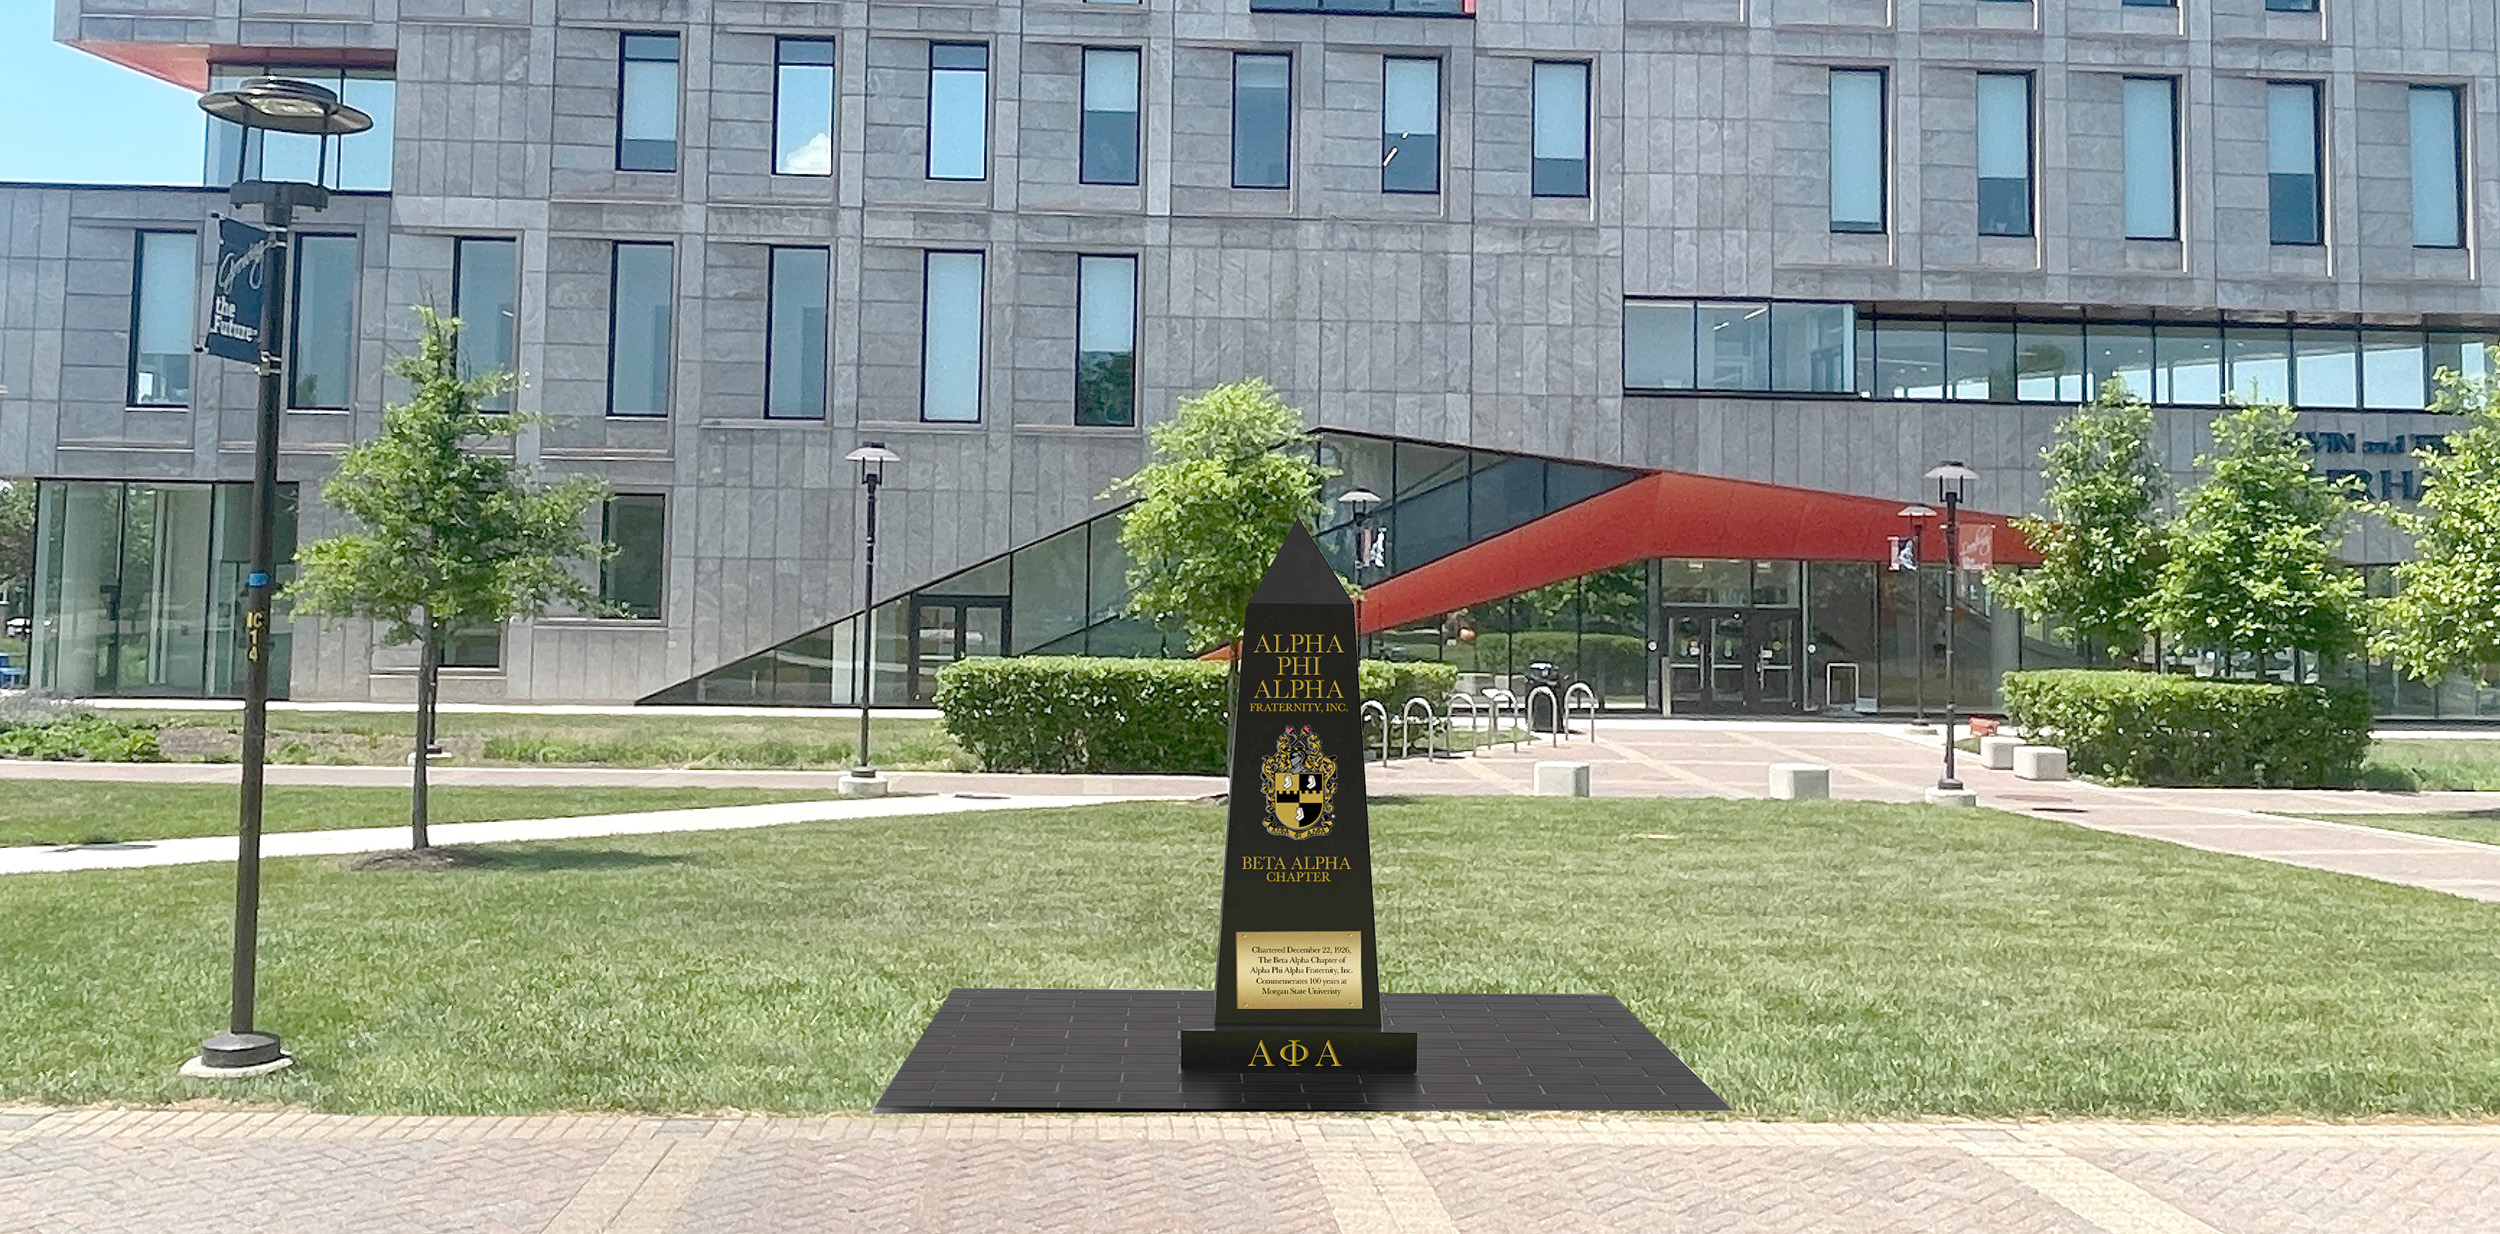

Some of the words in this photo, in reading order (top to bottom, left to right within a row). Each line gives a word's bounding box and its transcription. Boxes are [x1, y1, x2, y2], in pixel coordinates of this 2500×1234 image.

[216, 295, 236, 318] the
[1254, 633, 1345, 653] ALPHA
[1277, 656, 1322, 676] PHI
[1254, 679, 1345, 699] ALPHA
[1250, 703, 1323, 713] FRATERNITY,
[1326, 703, 1348, 712] INC.
[1242, 856, 1287, 870] BETA
[1291, 856, 1352, 870] ALPHA
[1266, 872, 1331, 882] CHAPTER
[1251, 946, 1286, 954] Chartered
[1322, 946, 1332, 955] 22,
[1289, 956, 1309, 965] Alpha
[1311, 957, 1337, 965] Chapter
[1250, 967, 1270, 975] Alpha
[1284, 967, 1304, 975] Alpha
[1306, 967, 1339, 975] Fraternity,
[1262, 988, 1289, 996] Morgan
